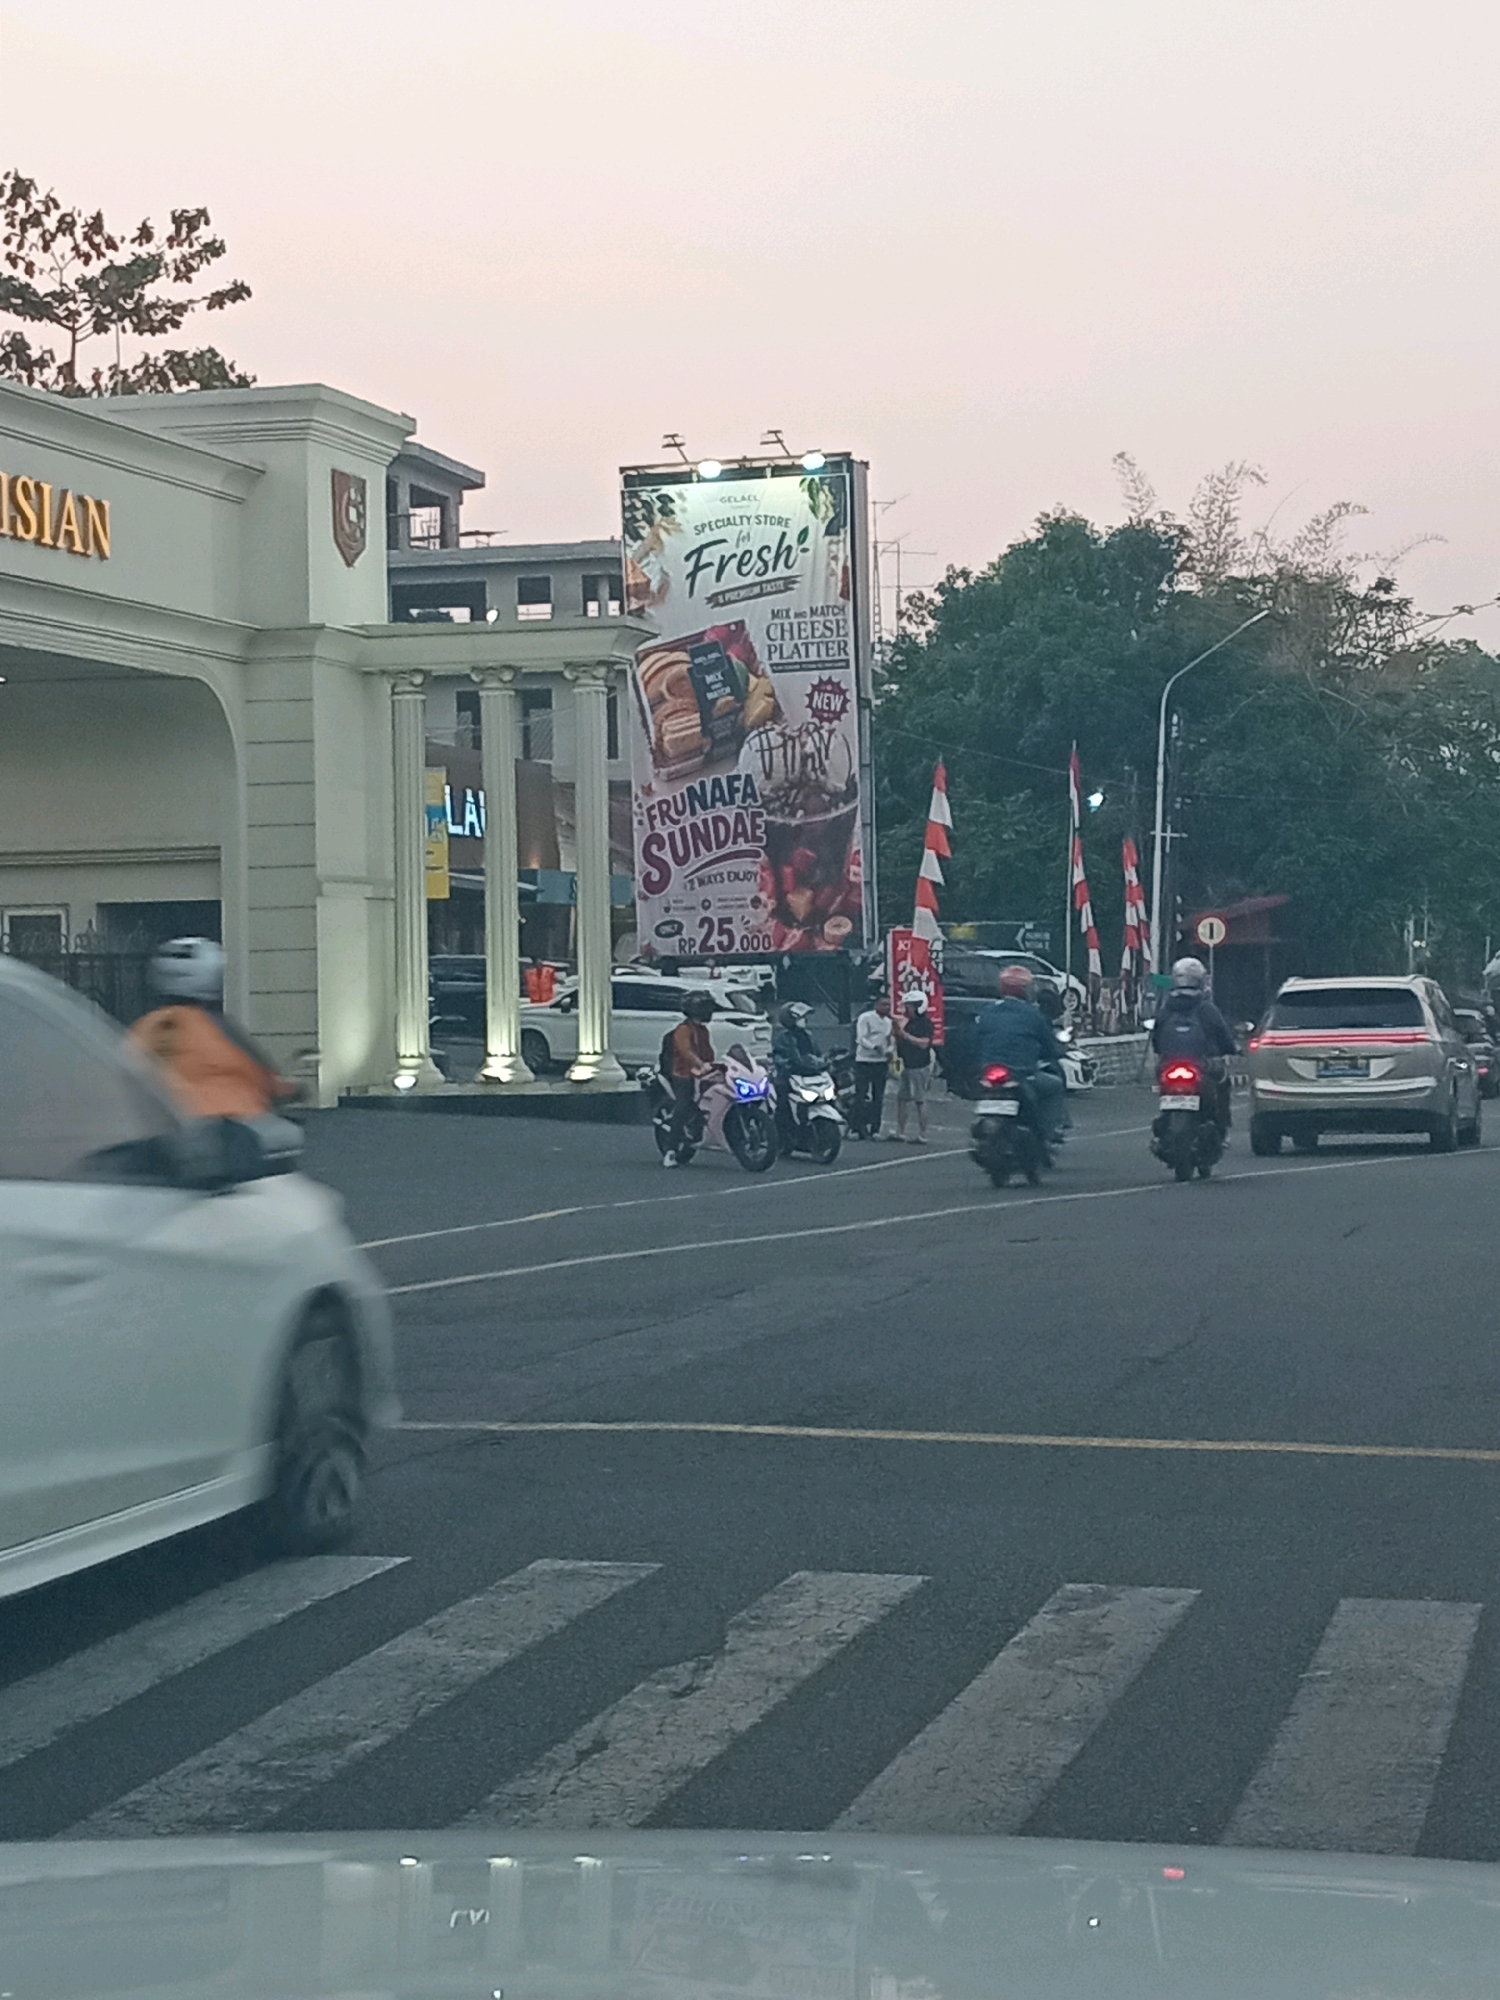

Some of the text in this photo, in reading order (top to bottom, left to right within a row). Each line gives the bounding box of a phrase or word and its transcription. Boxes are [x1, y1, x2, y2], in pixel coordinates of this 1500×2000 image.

[694, 514, 791, 536] SPECIALTY STORE
[684, 531, 799, 599] Fresh
[771, 607, 791, 620] MIX
[809, 604, 846, 618] MATCH
[766, 618, 849, 642] CHEESE
[767, 639, 850, 661] PLATTER
[812, 690, 844, 712] NEW
[646, 773, 760, 832] FRUNAFA
[642, 810, 765, 895] SUNDAE
